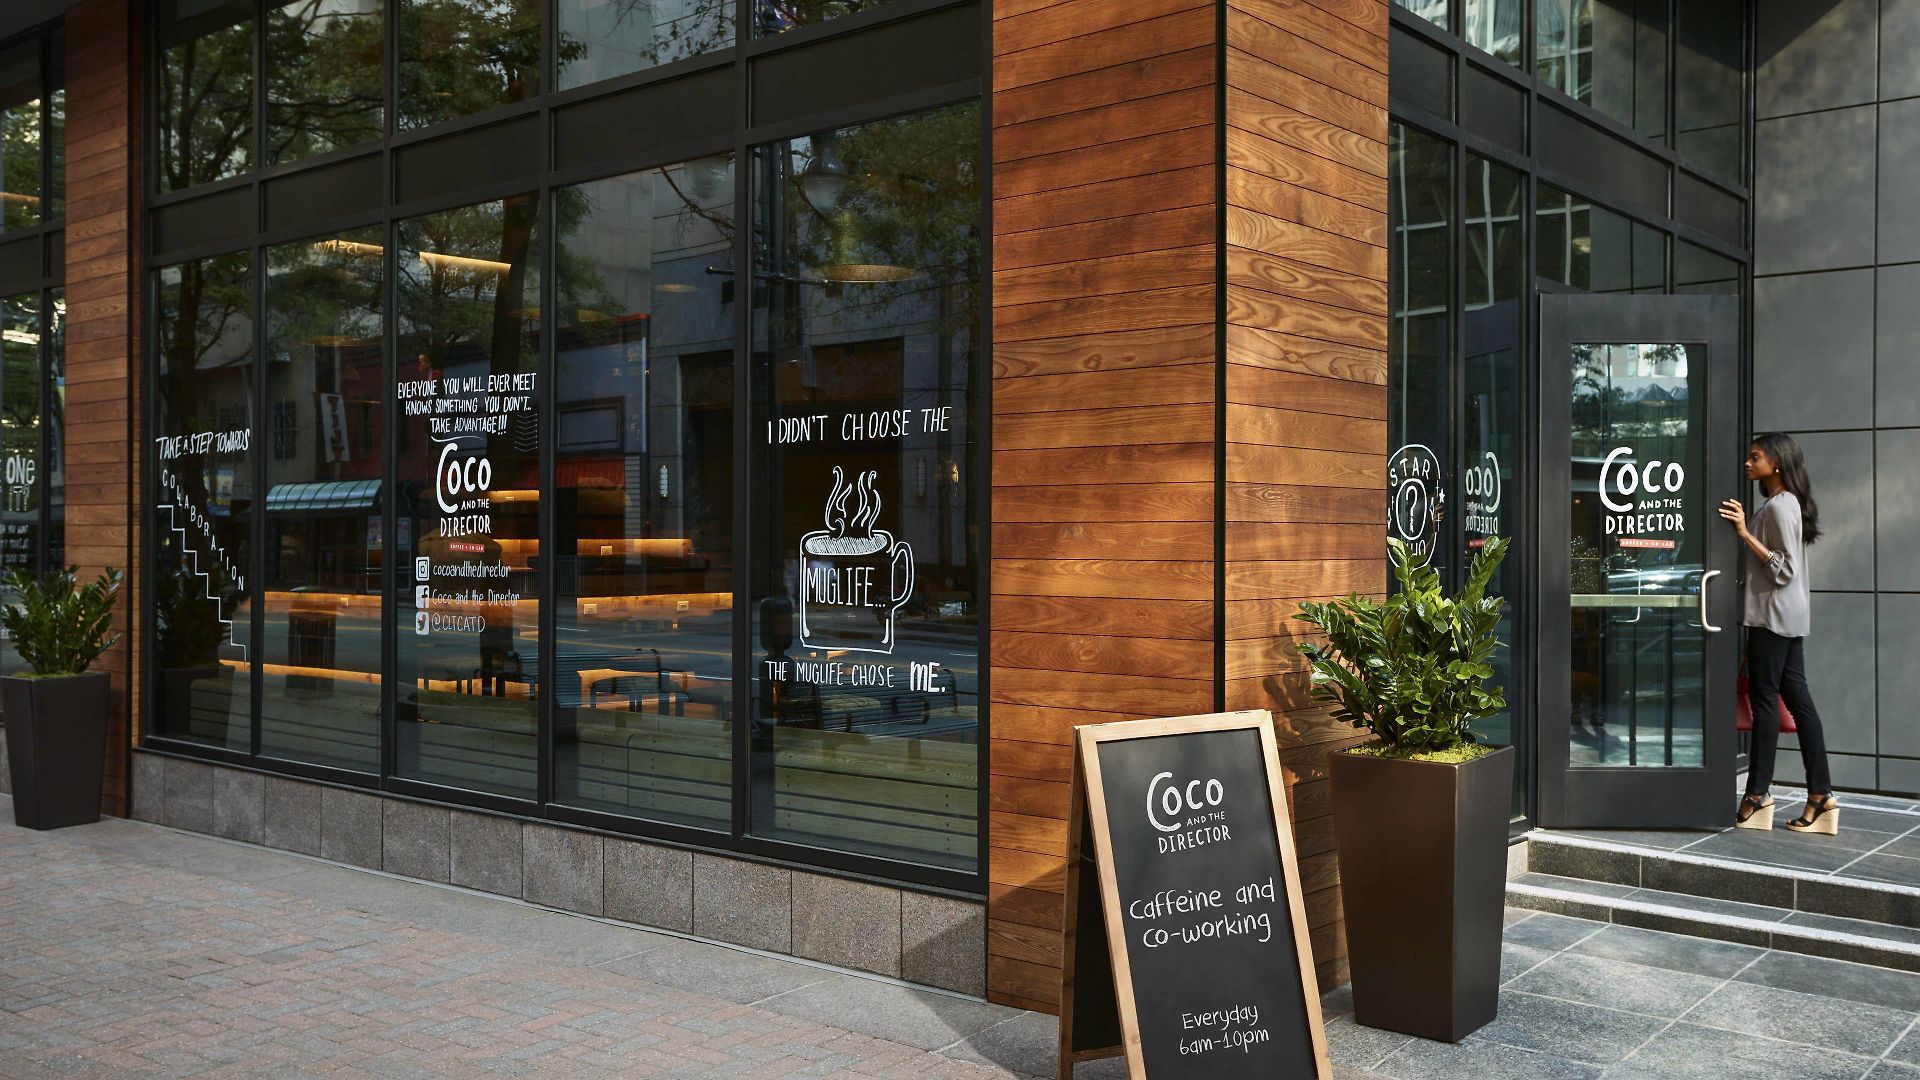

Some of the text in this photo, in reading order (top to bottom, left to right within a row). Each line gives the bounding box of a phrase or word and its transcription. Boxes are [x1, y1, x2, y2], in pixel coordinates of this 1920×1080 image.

[397, 373, 537, 399] EVERYONE YOU WILL EVER MEET
[405, 400, 433, 416] KNOWS
[435, 397, 478, 414] SOMETHING
[484, 396, 500, 413] YOU
[430, 417, 450, 434] TAKE
[767, 406, 952, 444] I DIDN'T CHOOSE THE
[155, 436, 182, 460] TAKE
[189, 431, 214, 455] STEP
[214, 428, 250, 453] TOWARDS
[461, 498, 490, 511] AND THE
[1638, 498, 1682, 510] AND THE
[440, 514, 491, 538] DIRECTOR
[1605, 513, 1685, 535] DIRECTOR
[433, 559, 512, 578] cocoandthedirector
[432, 588, 520, 607] Coco and the Director
[431, 612, 486, 633] @CLTCATD
[765, 660, 788, 681] THE
[796, 661, 843, 686] MUGLIFE
[851, 664, 894, 688] CHOSE
[1186, 810, 1226, 828] AND THE
[1158, 824, 1232, 854] DIRECTOR
[1129, 877, 1276, 919] Caffeine and
[1182, 1004, 1258, 1030] Everyday
[1179, 1029, 1270, 1056] 6am-10pm
